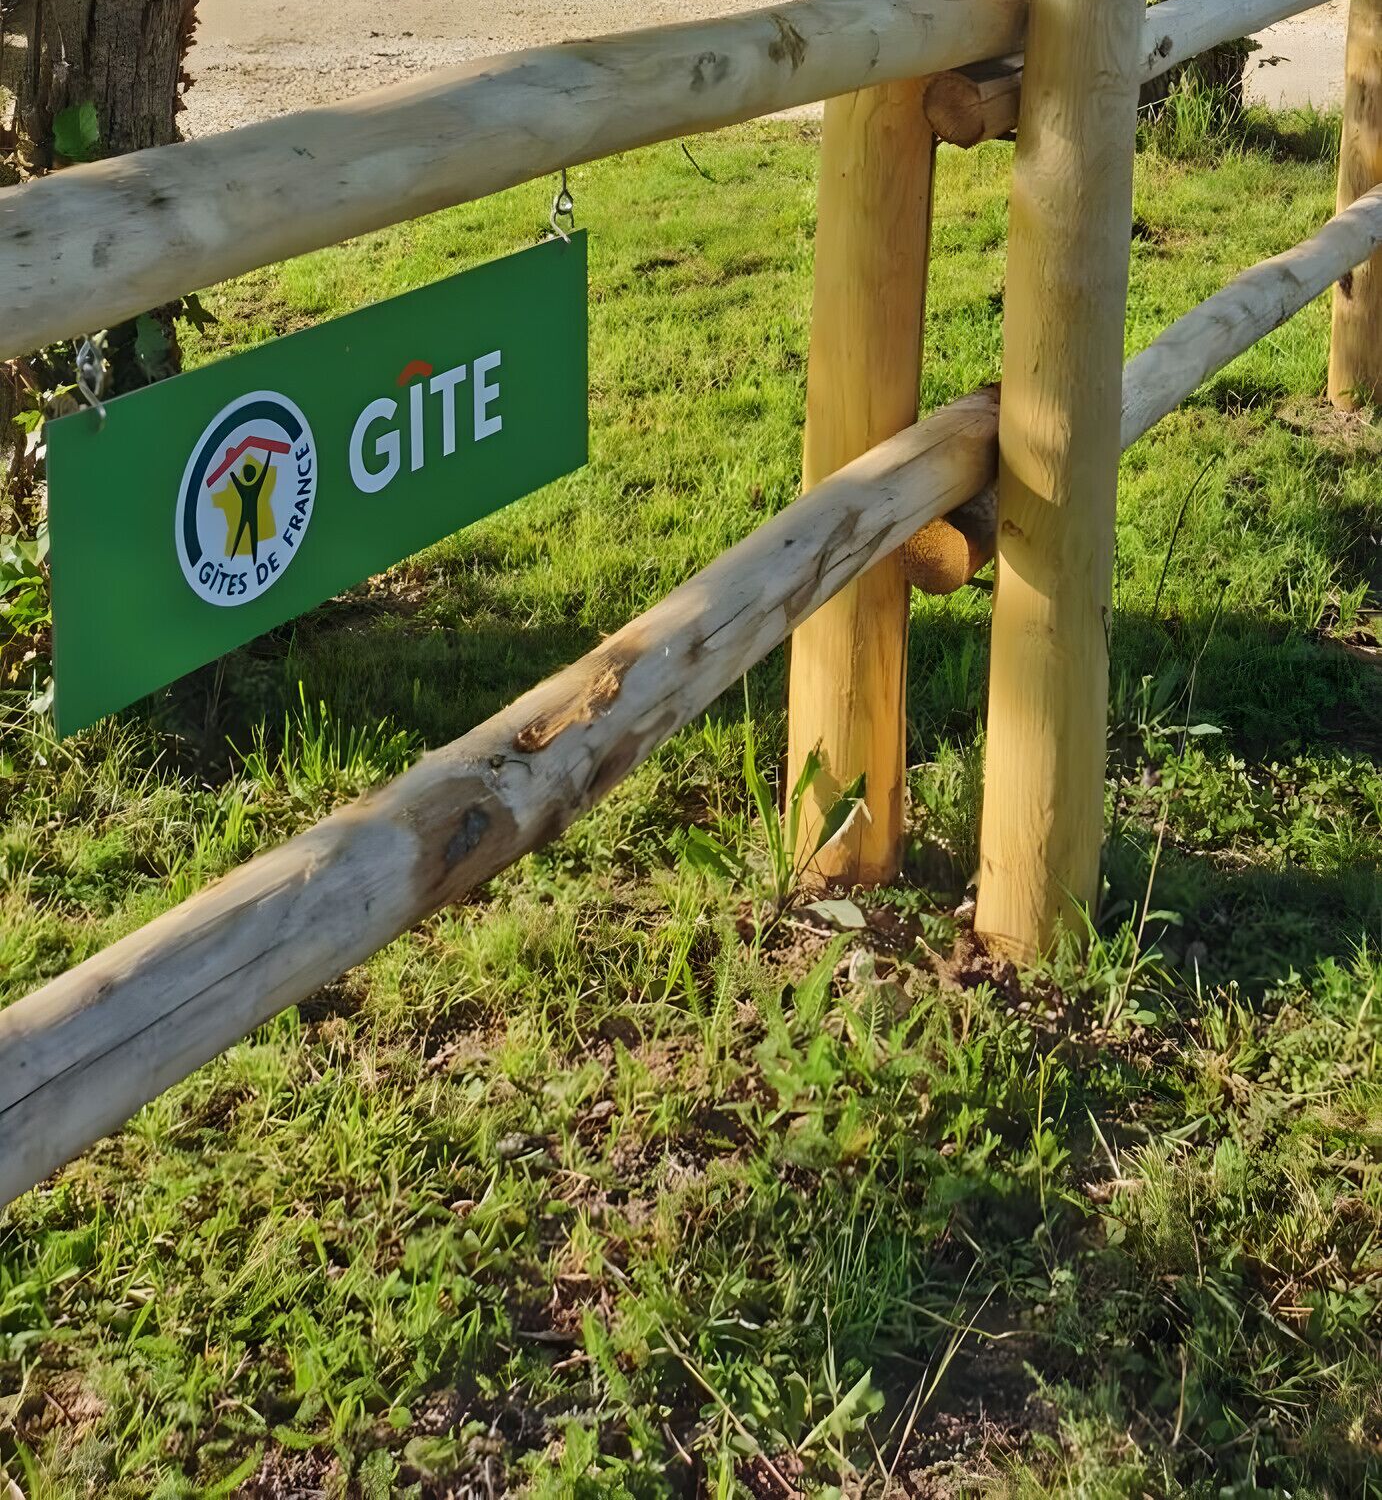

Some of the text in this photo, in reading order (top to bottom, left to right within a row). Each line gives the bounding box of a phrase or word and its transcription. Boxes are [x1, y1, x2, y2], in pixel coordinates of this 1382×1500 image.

[349, 349, 502, 494] GÎTE
[256, 551, 280, 586] DE
[282, 442, 312, 548] FRANCE
